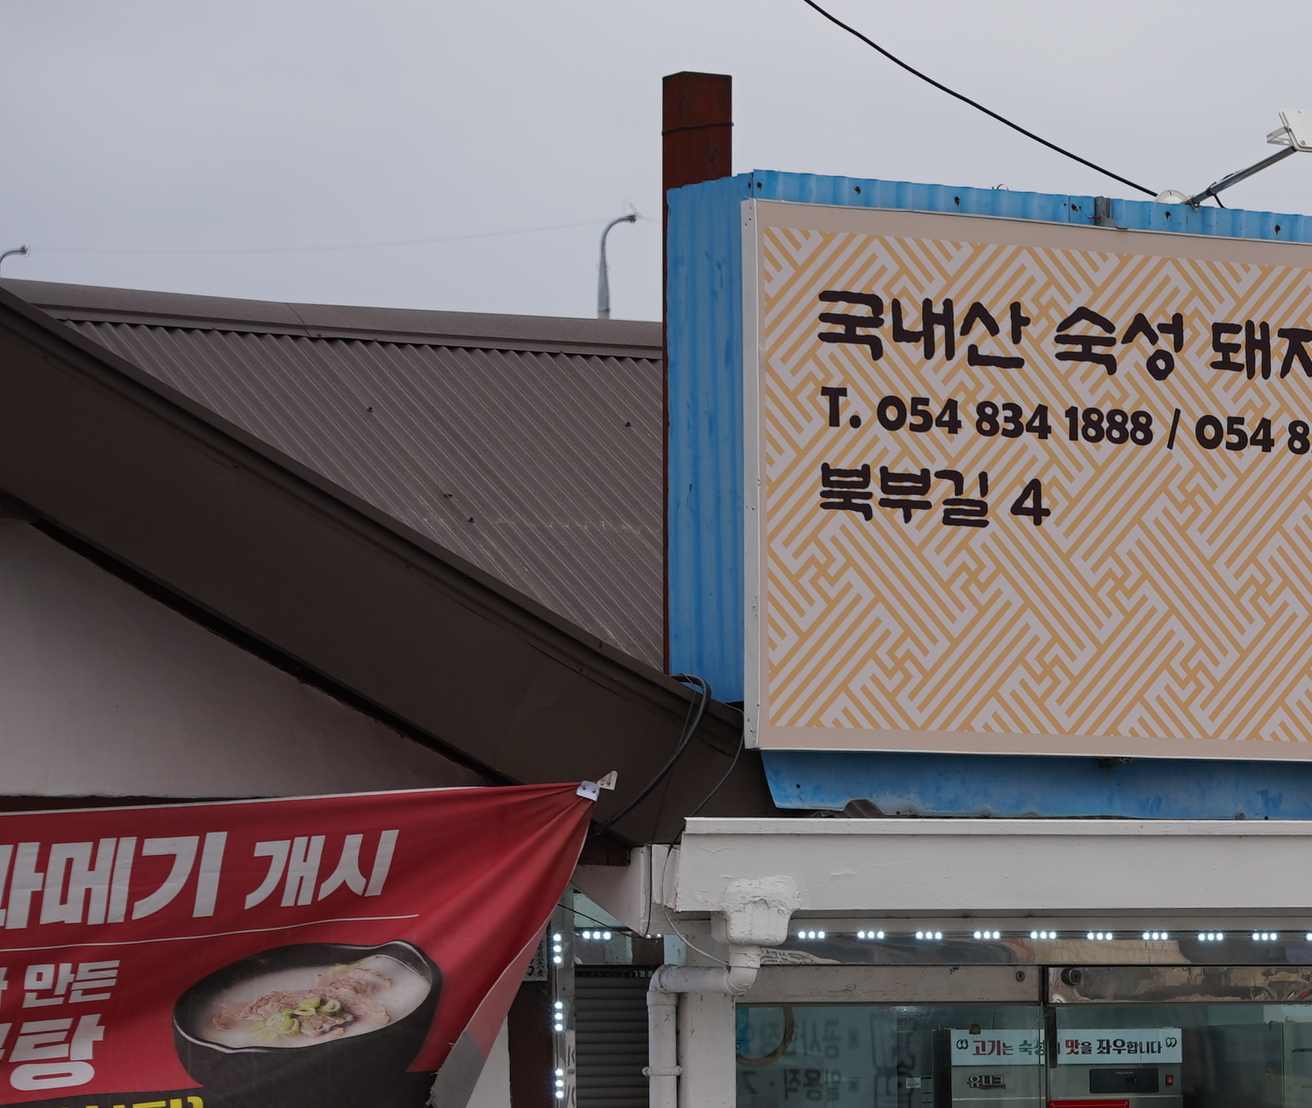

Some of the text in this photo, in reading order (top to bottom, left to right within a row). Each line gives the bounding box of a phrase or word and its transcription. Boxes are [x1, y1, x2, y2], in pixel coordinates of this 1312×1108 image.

[817, 290, 1029, 369] 국내산
[1054, 306, 1184, 380] 숙성
[820, 386, 861, 428] T.
[876, 395, 962, 434] 054
[975, 400, 1051, 439] 834
[1065, 406, 1153, 446] 1888
[1195, 414, 1274, 452] 054
[820, 462, 1051, 527] 북부길 4
[244, 829, 400, 909] 개시
[22, 959, 121, 1008] 만든
[0, 1013, 106, 1091] 탕
[972, 1039, 1013, 1056] 고기는
[1065, 1039, 1092, 1056] 맛을
[1097, 1038, 1162, 1056] 좌우합니다
